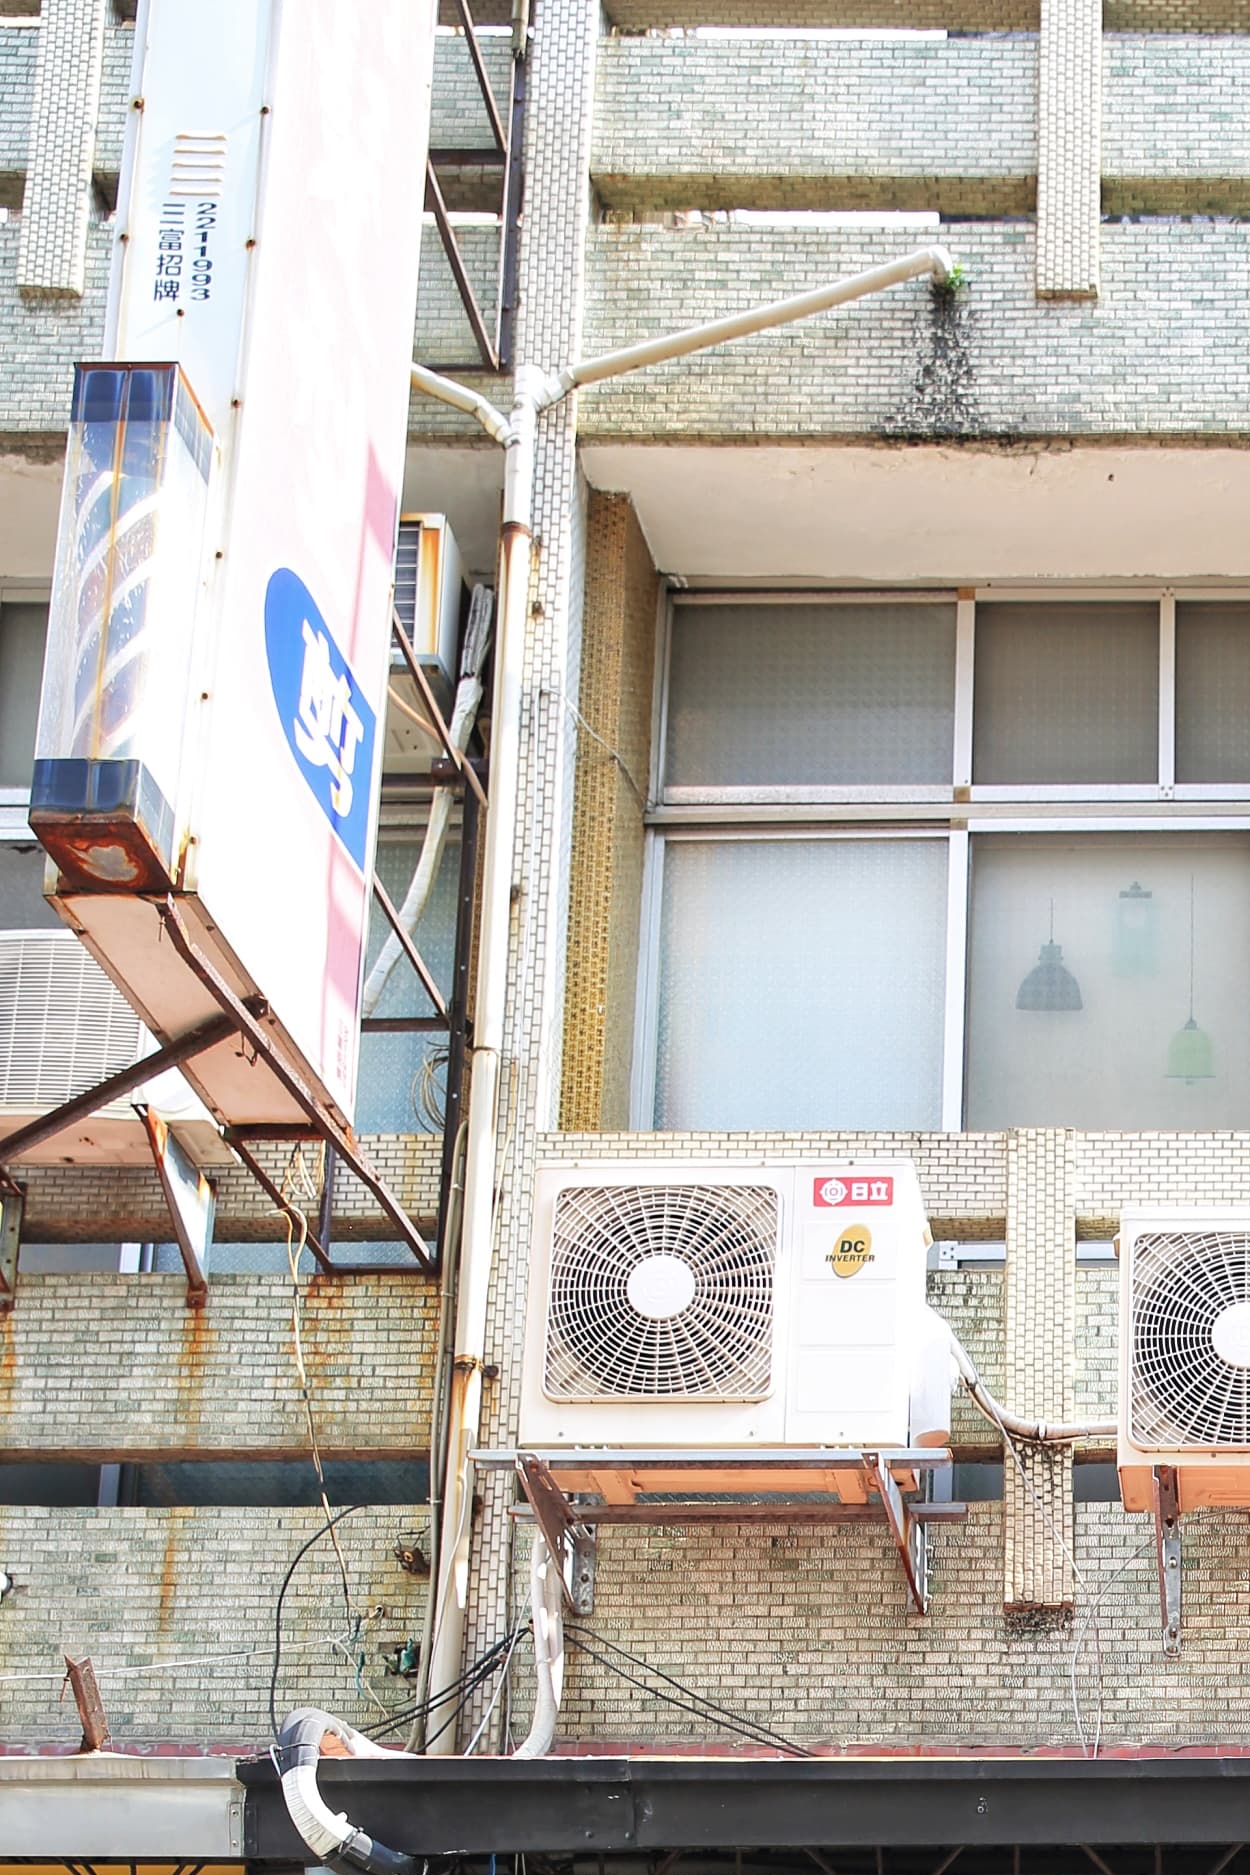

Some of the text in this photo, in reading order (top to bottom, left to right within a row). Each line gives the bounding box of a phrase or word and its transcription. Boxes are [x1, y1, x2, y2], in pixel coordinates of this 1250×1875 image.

[154, 203, 186, 302] 三富招牌
[191, 202, 218, 301] 2211993
[851, 1181, 889, 1201] 日立
[840, 1240, 865, 1253] DC
[825, 1254, 875, 1262] INVERTER
